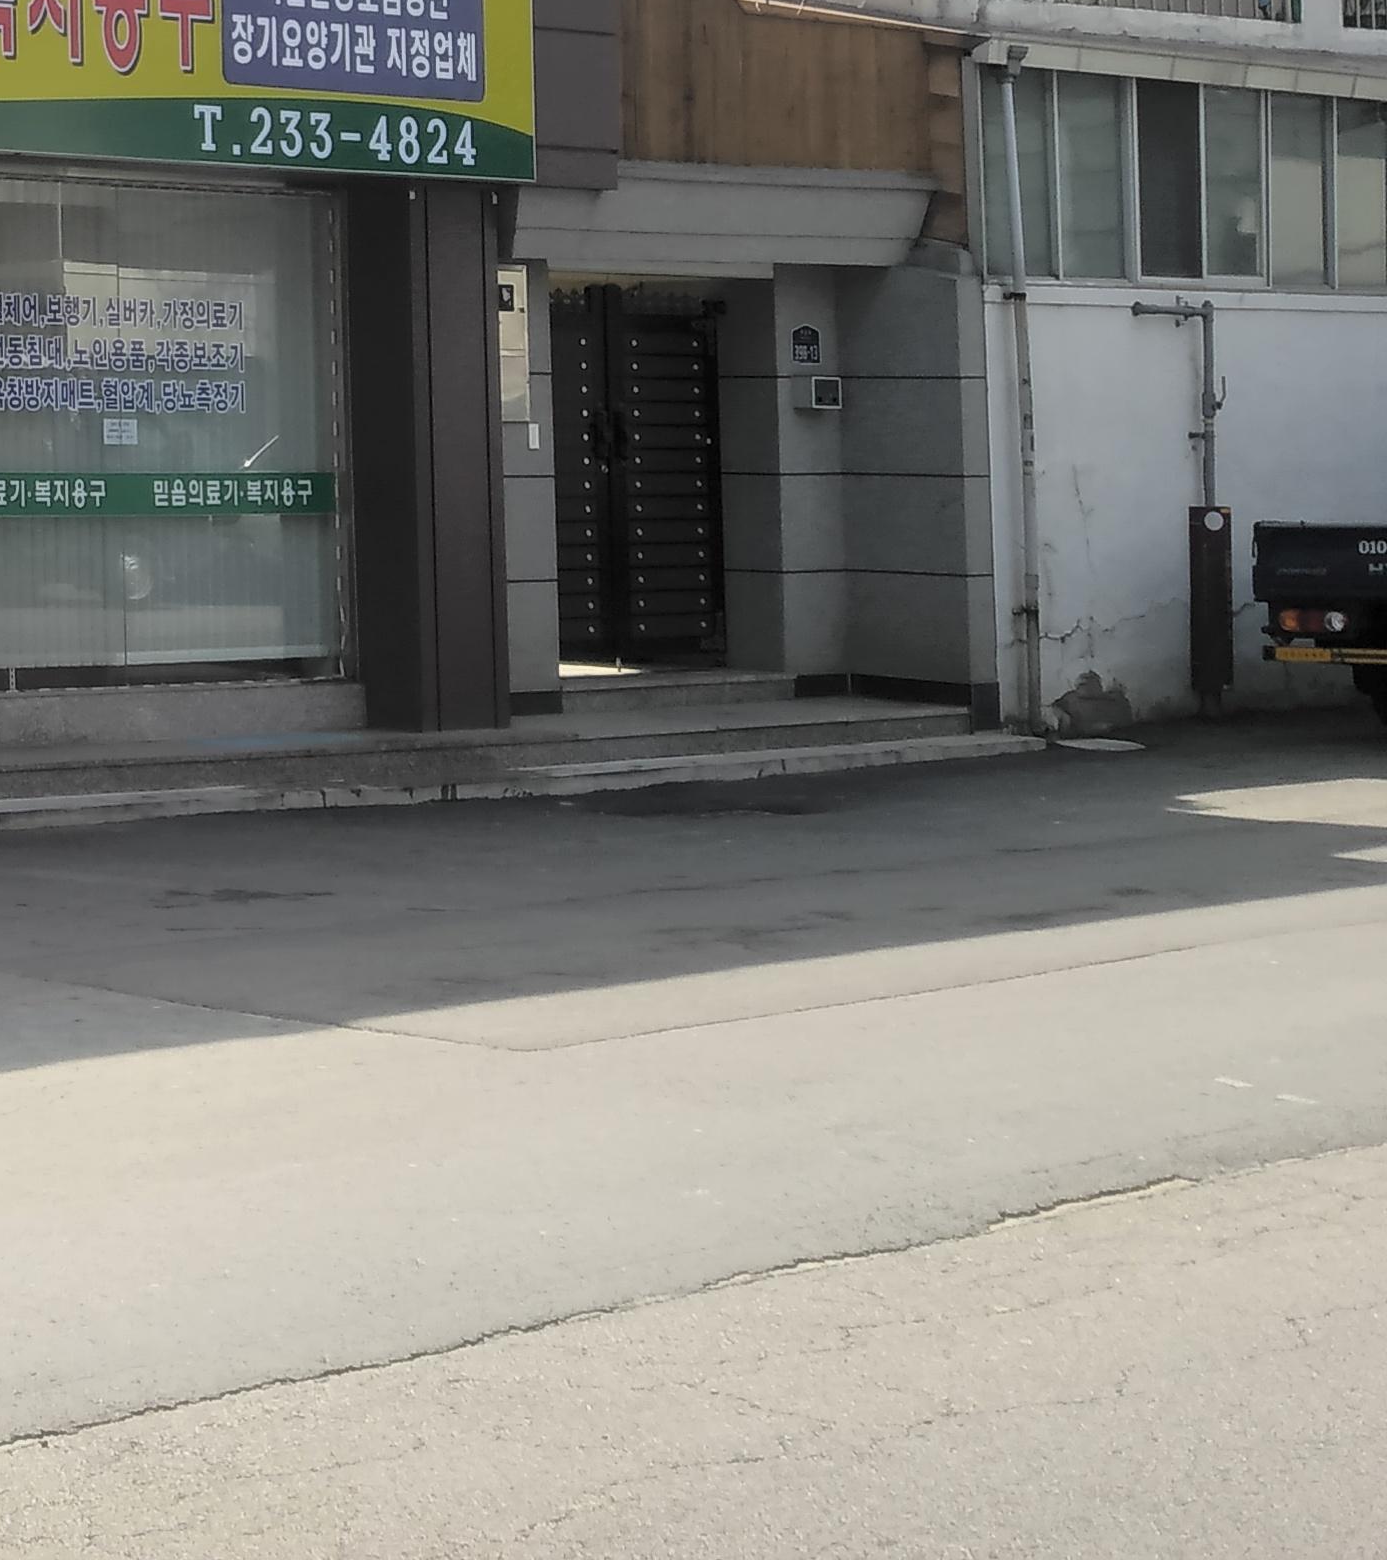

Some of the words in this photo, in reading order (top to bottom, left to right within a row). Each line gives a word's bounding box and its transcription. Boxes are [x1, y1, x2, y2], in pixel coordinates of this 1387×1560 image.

[230, 12, 377, 75] 장기요양기관
[386, 26, 478, 82] 지정업체
[193, 103, 477, 167] T.233-4824
